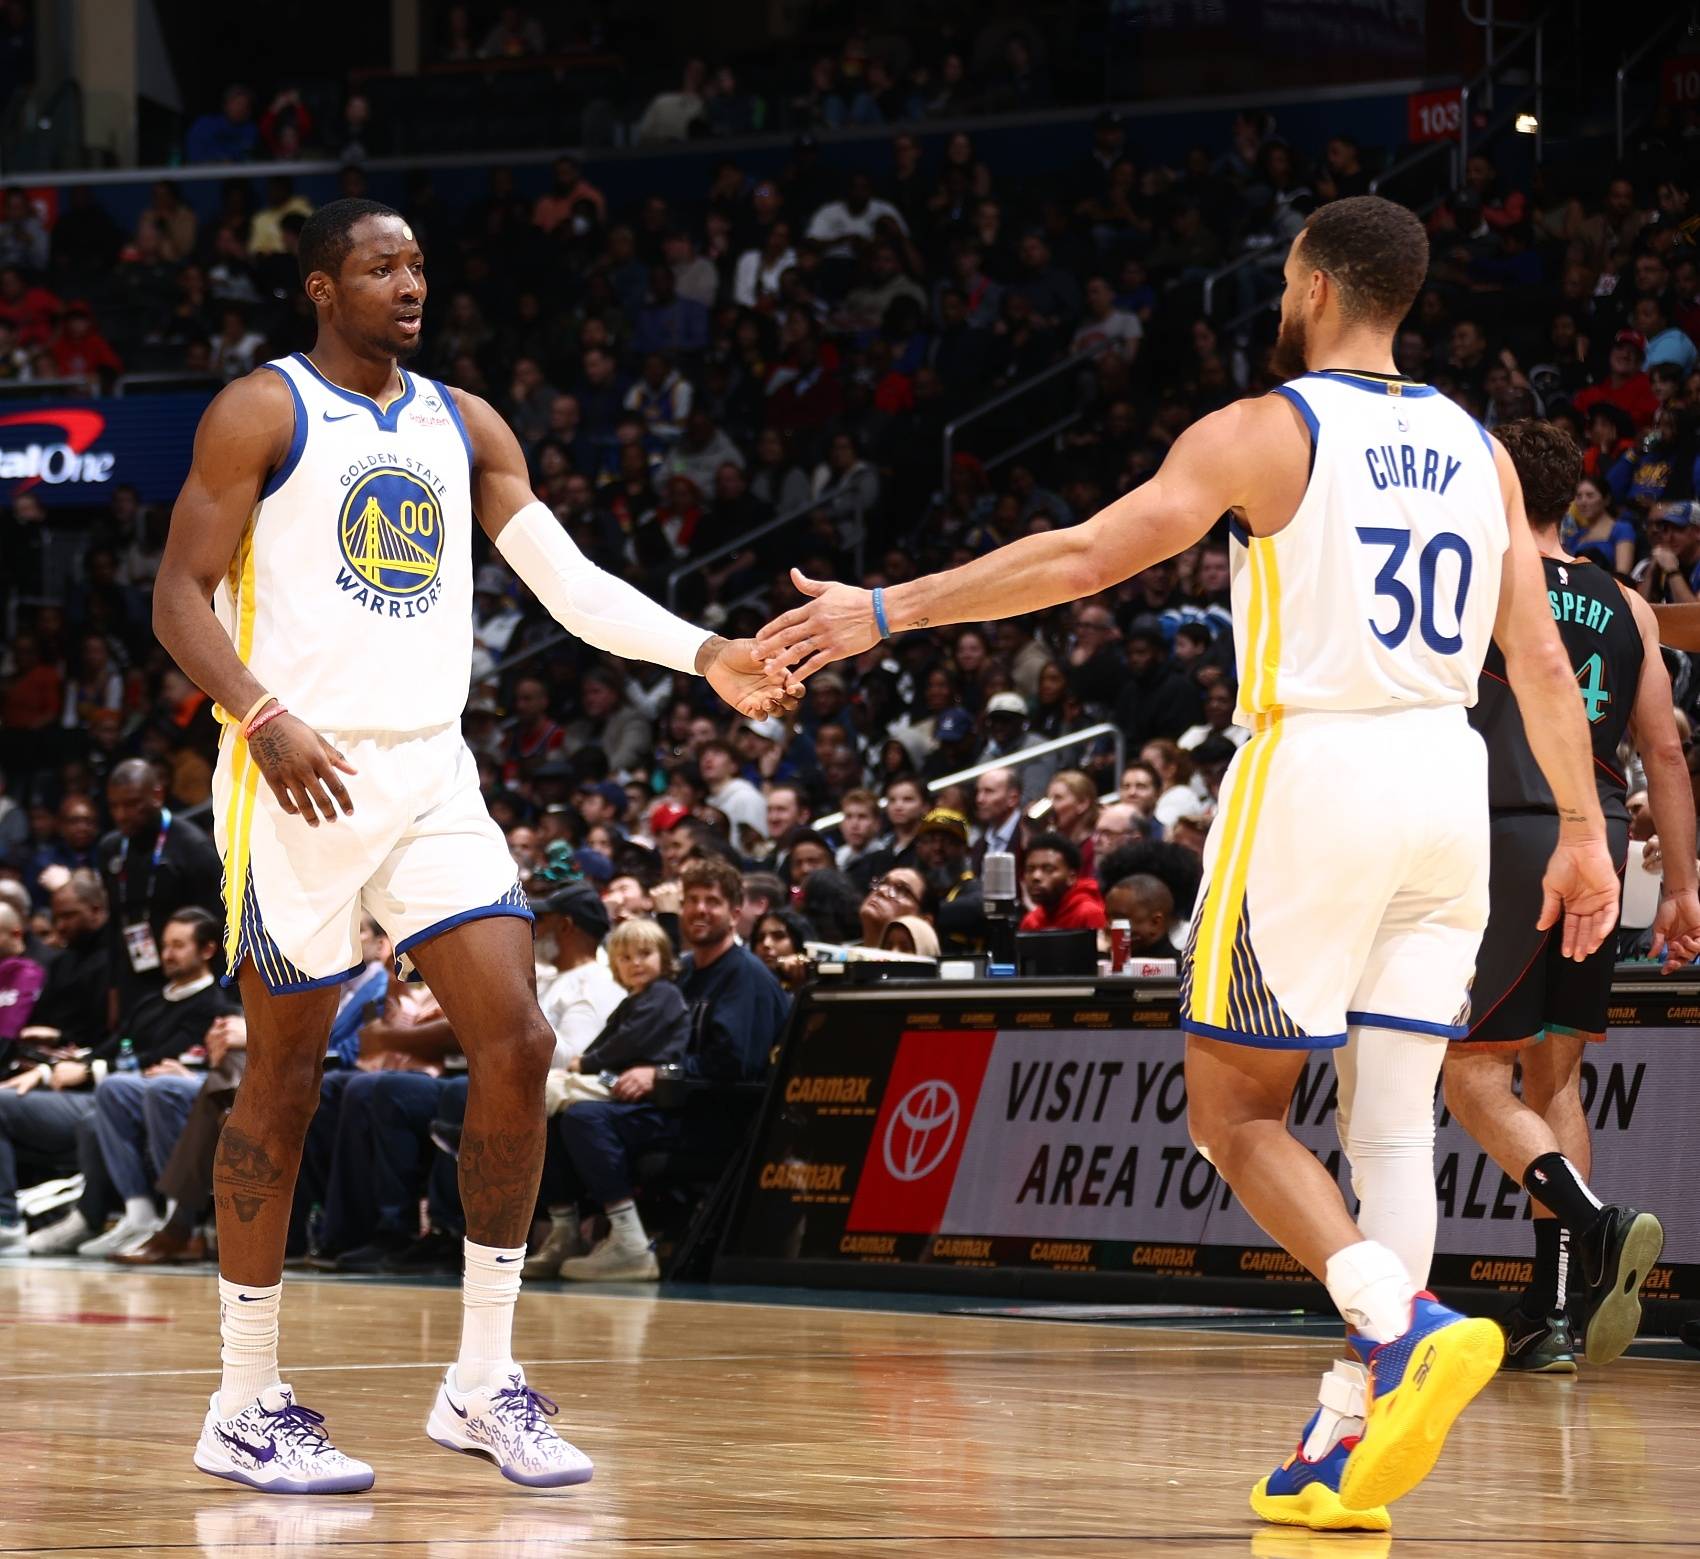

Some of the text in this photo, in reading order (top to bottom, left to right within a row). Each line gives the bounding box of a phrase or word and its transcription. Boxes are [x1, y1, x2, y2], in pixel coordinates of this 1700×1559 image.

[1419, 101, 1460, 134] 103
[340, 453, 447, 497] GOLDEN STATE
[1366, 444, 1462, 496] CURRY
[401, 500, 434, 537] 00
[335, 566, 443, 619] WARRIORS
[1355, 526, 1473, 656] 30
[1547, 590, 1615, 635] SPERT
[1006, 1061, 1123, 1123] VISIT
[1016, 1144, 1139, 1208] AREA
